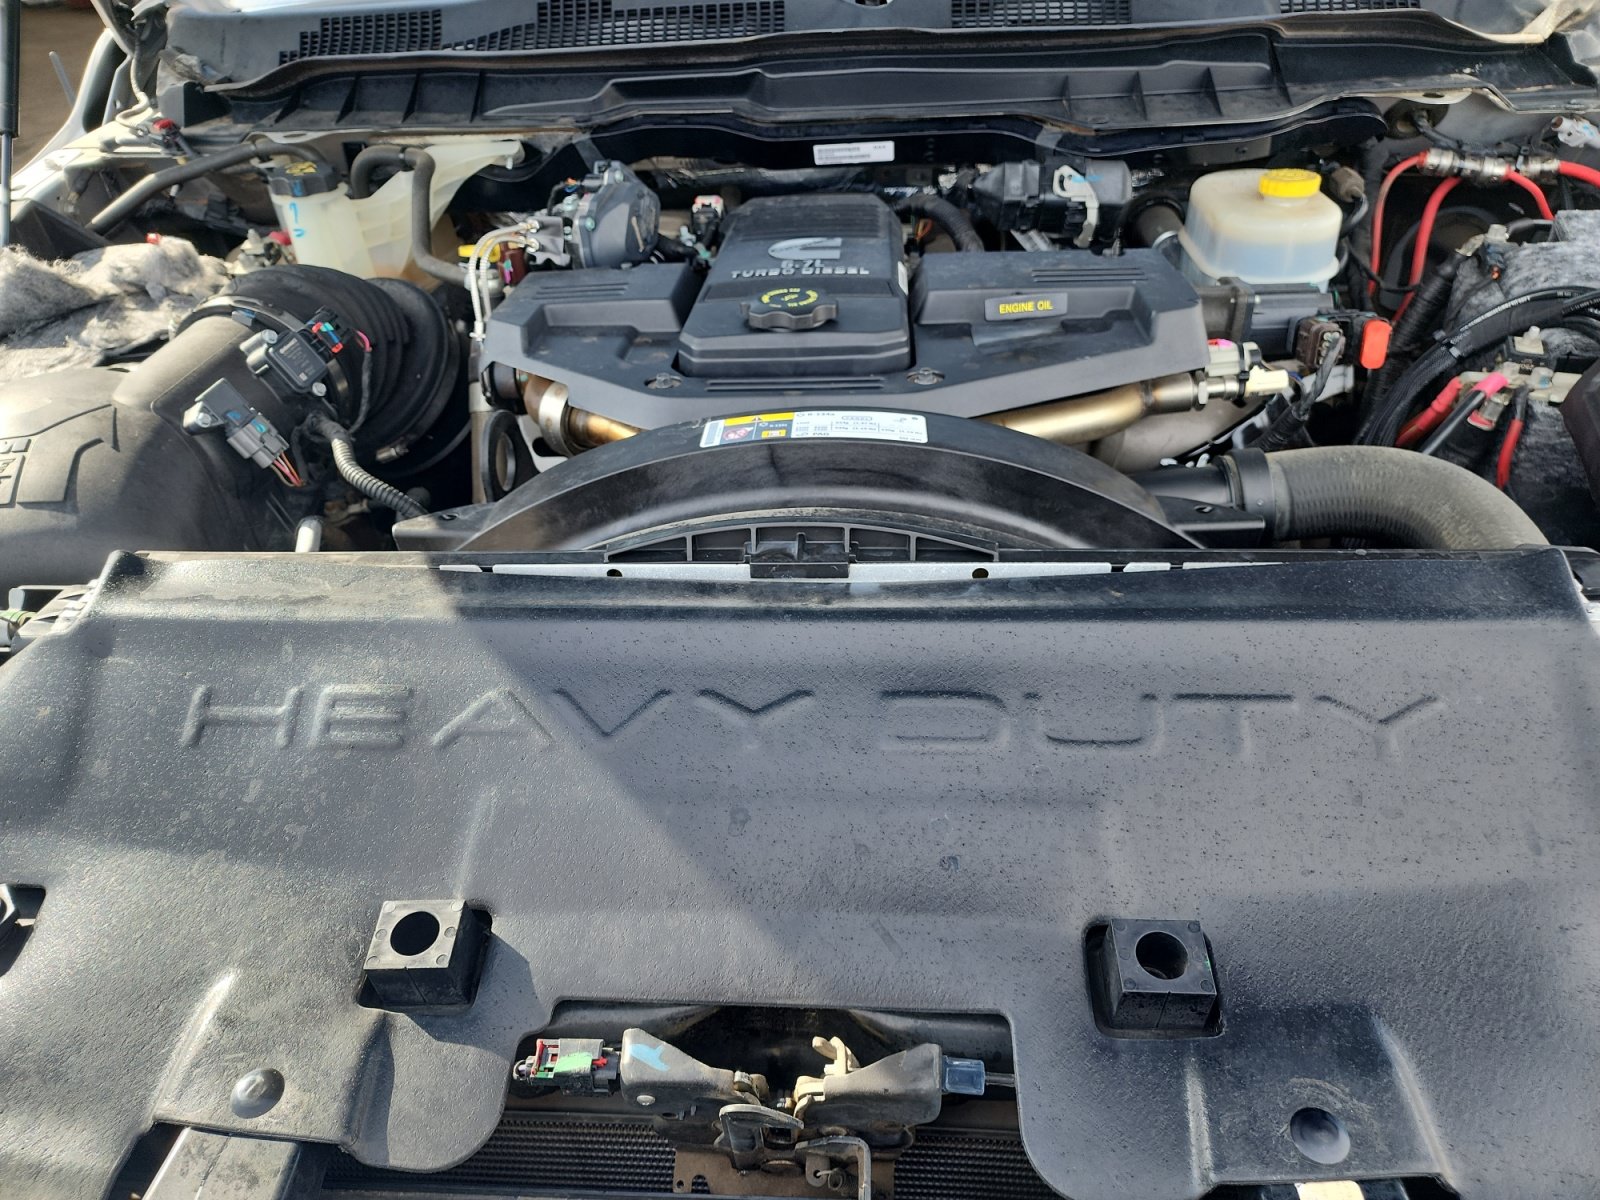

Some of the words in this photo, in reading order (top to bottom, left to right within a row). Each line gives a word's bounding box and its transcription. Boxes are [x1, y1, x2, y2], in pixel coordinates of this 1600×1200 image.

[780, 259, 825, 269] 6.7L
[731, 267, 795, 278] TURBO
[801, 266, 870, 275] DIESEL
[999, 300, 1035, 314] ENGINE
[1036, 299, 1054, 311] OIL
[180, 684, 816, 751] HEAVY
[880, 690, 1446, 762] DUTY
